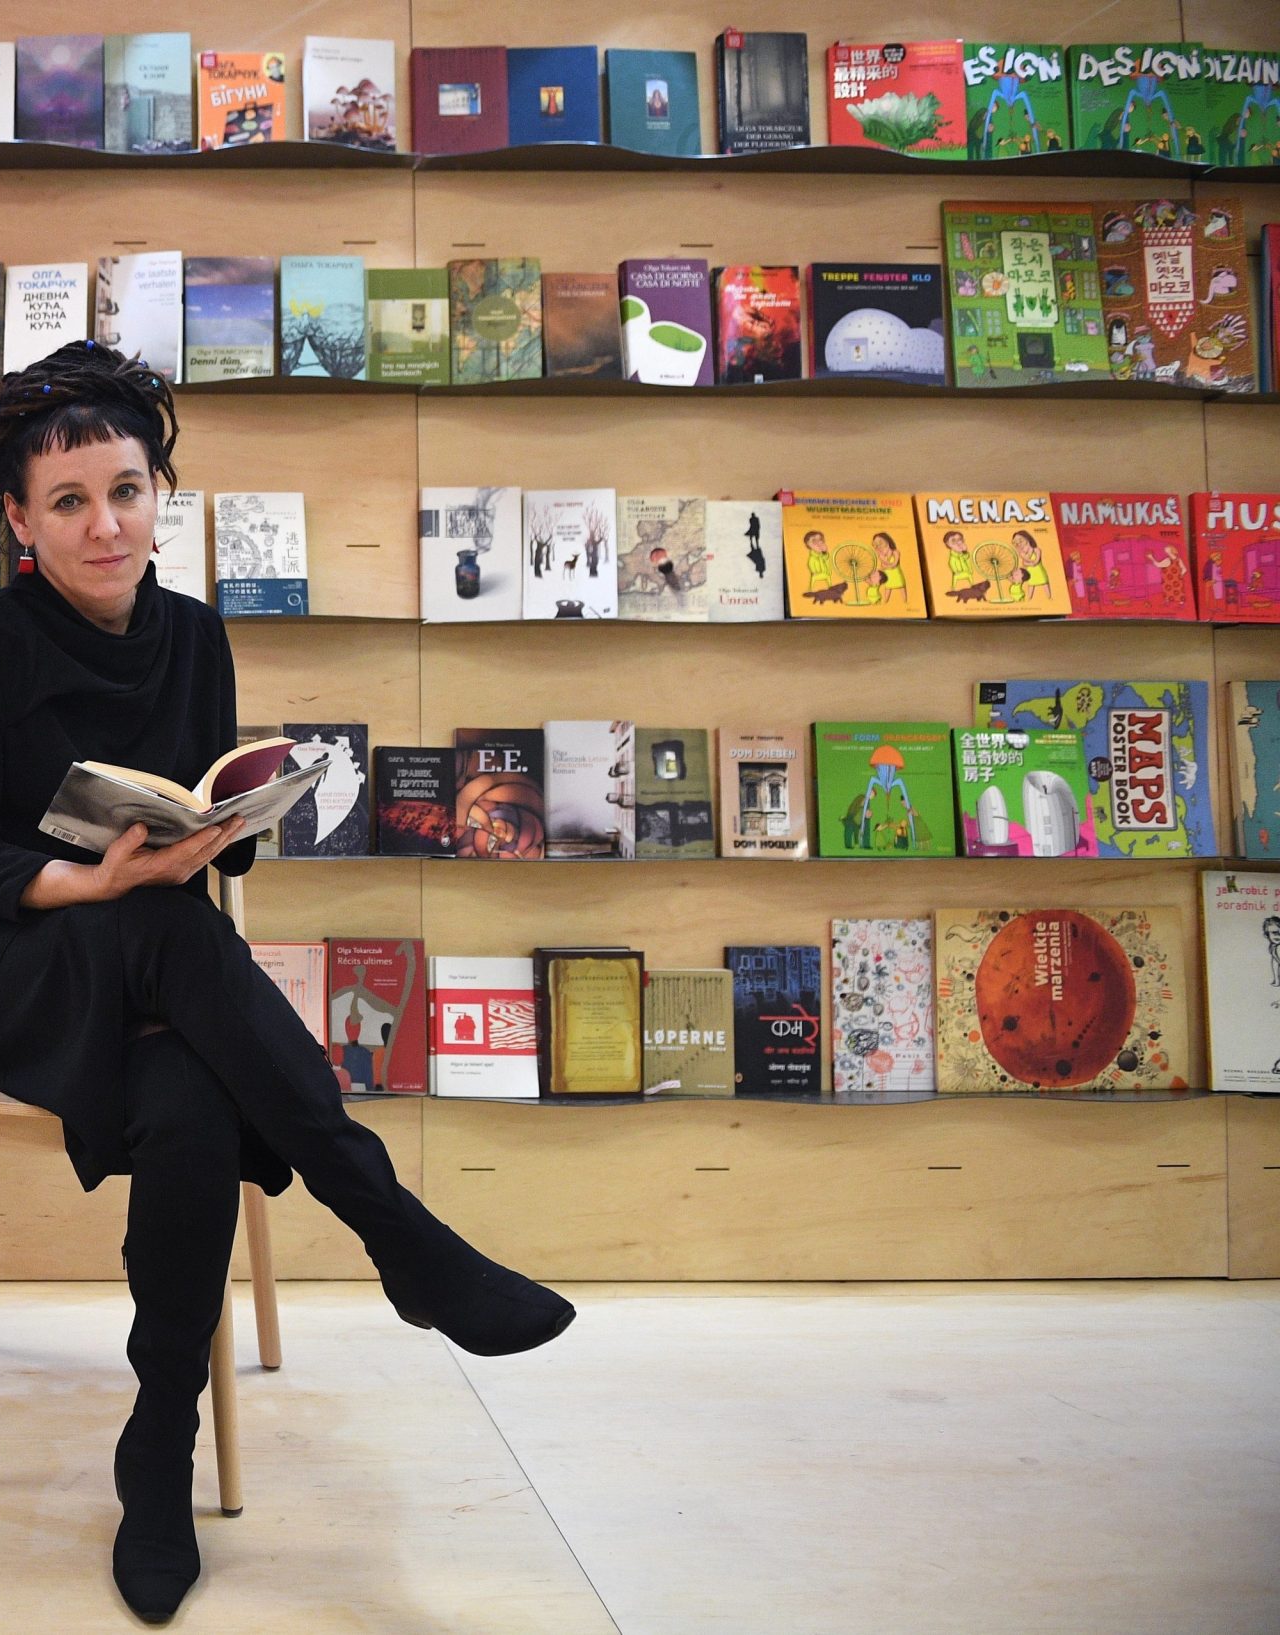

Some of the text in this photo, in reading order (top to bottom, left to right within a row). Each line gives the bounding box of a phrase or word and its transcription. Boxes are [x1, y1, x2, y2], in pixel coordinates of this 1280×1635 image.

[963, 46, 1062, 86] ESIGN
[1078, 46, 1202, 87] DESIGN
[210, 84, 268, 107] БІГУНИ
[1011, 253, 1044, 268] 도시
[32, 270, 62, 280] ОЛГА
[133, 267, 178, 281] de laatste
[821, 273, 932, 283] TREPPE FENSTER KLO
[1007, 269, 1053, 284] 마모코
[17, 279, 77, 291] ТОКАРЧУК
[137, 278, 178, 291] verhalen
[1149, 280, 1191, 296] 마모코
[23, 291, 70, 303] ДНЕВНА
[25, 311, 67, 322] НОЋНА
[30, 321, 62, 332] КУЋА
[719, 594, 759, 606] Unrast
[477, 749, 529, 774] E.E.
[960, 750, 1024, 769] 最奇妙的
[963, 768, 996, 786] 房子
[1112, 713, 1131, 827] POSTER BOOK
[1127, 711, 1168, 828] MAPS
[1240, 885, 1269, 897] robić
[337, 946, 383, 959] Olga Tokarczuk
[1033, 921, 1050, 987] Wielkie
[337, 954, 393, 967] Récits ultimes
[1049, 920, 1064, 1002] marzenia
[643, 1030, 726, 1045] LØPERNE
